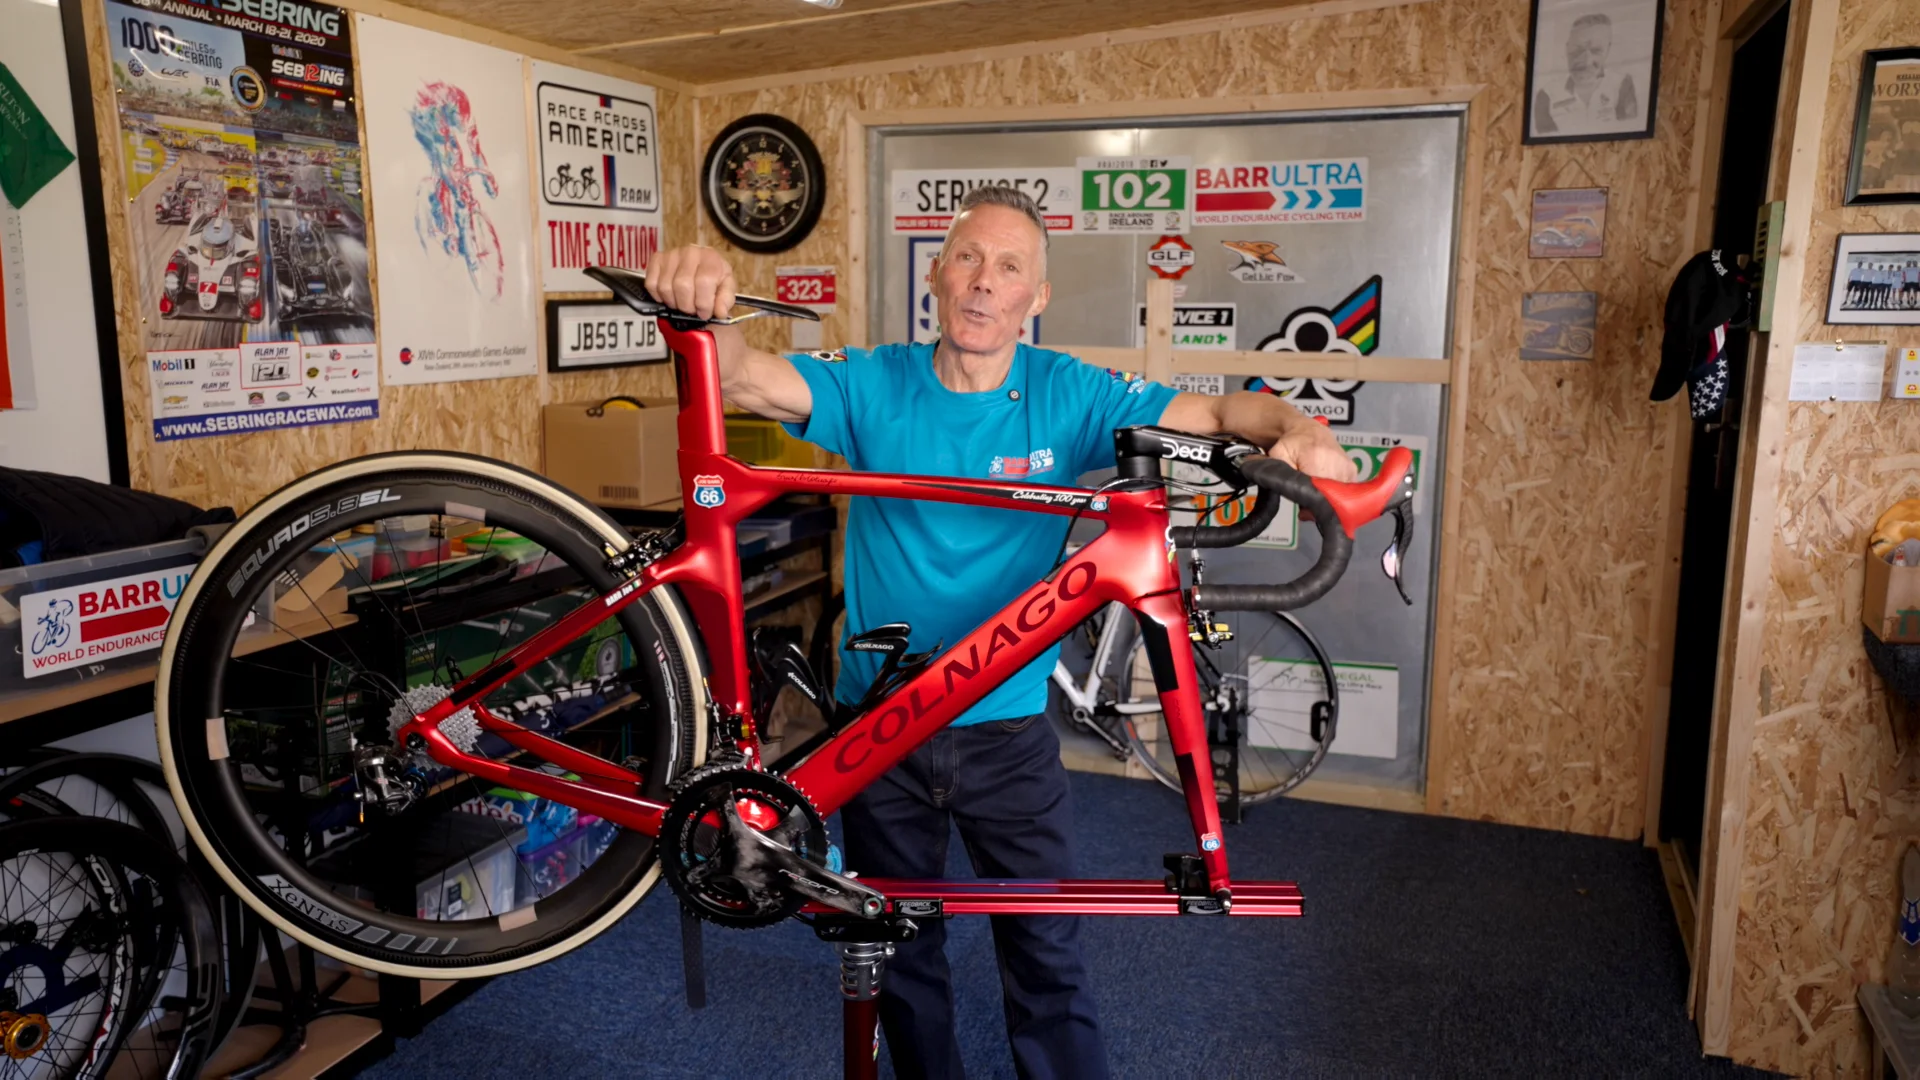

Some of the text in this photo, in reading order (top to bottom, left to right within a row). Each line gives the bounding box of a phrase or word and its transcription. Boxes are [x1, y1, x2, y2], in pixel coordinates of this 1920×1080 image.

[163, 1, 213, 21] ANNUAL
[223, 14, 263, 32] MARCH
[294, 31, 326, 47] 2020
[121, 17, 176, 56] 1000
[547, 102, 647, 132] RACE ACROSS
[549, 121, 649, 156] AMERICA
[620, 187, 652, 204] RAAM
[1093, 172, 1172, 208] 102
[1109, 218, 1154, 226] IRELAND
[1194, 211, 1362, 224] WORLD ENDURANCE CYCLING TEAM
[548, 220, 658, 270] TIME STATION
[1151, 251, 1191, 261] GLF
[786, 279, 823, 301] 323
[1220, 310, 1229, 325] 1
[570, 320, 657, 351] JB59 TJB
[1172, 334, 1215, 345] LAND
[254, 347, 289, 357] ALAN JAY
[437, 347, 481, 360] Commonwealth
[483, 346, 502, 357] Games
[503, 345, 527, 356] Auckland
[152, 359, 182, 371] Mobil
[252, 362, 290, 382] 120
[1174, 376, 1219, 384] ACROSS
[1298, 404, 1344, 416] NAGO
[161, 405, 373, 437] www.SEBRINGRACEWAY.com
[1160, 438, 1212, 463] Deda
[700, 490, 719, 504] 66
[1012, 490, 1053, 504] Celebrating
[1053, 494, 1073, 503] 100
[32, 629, 166, 669] WORLD ENDURANCE
[858, 642, 895, 650] COLNAGO
[833, 561, 1097, 774] COLNAGO
[791, 674, 816, 699] COLNAGO
